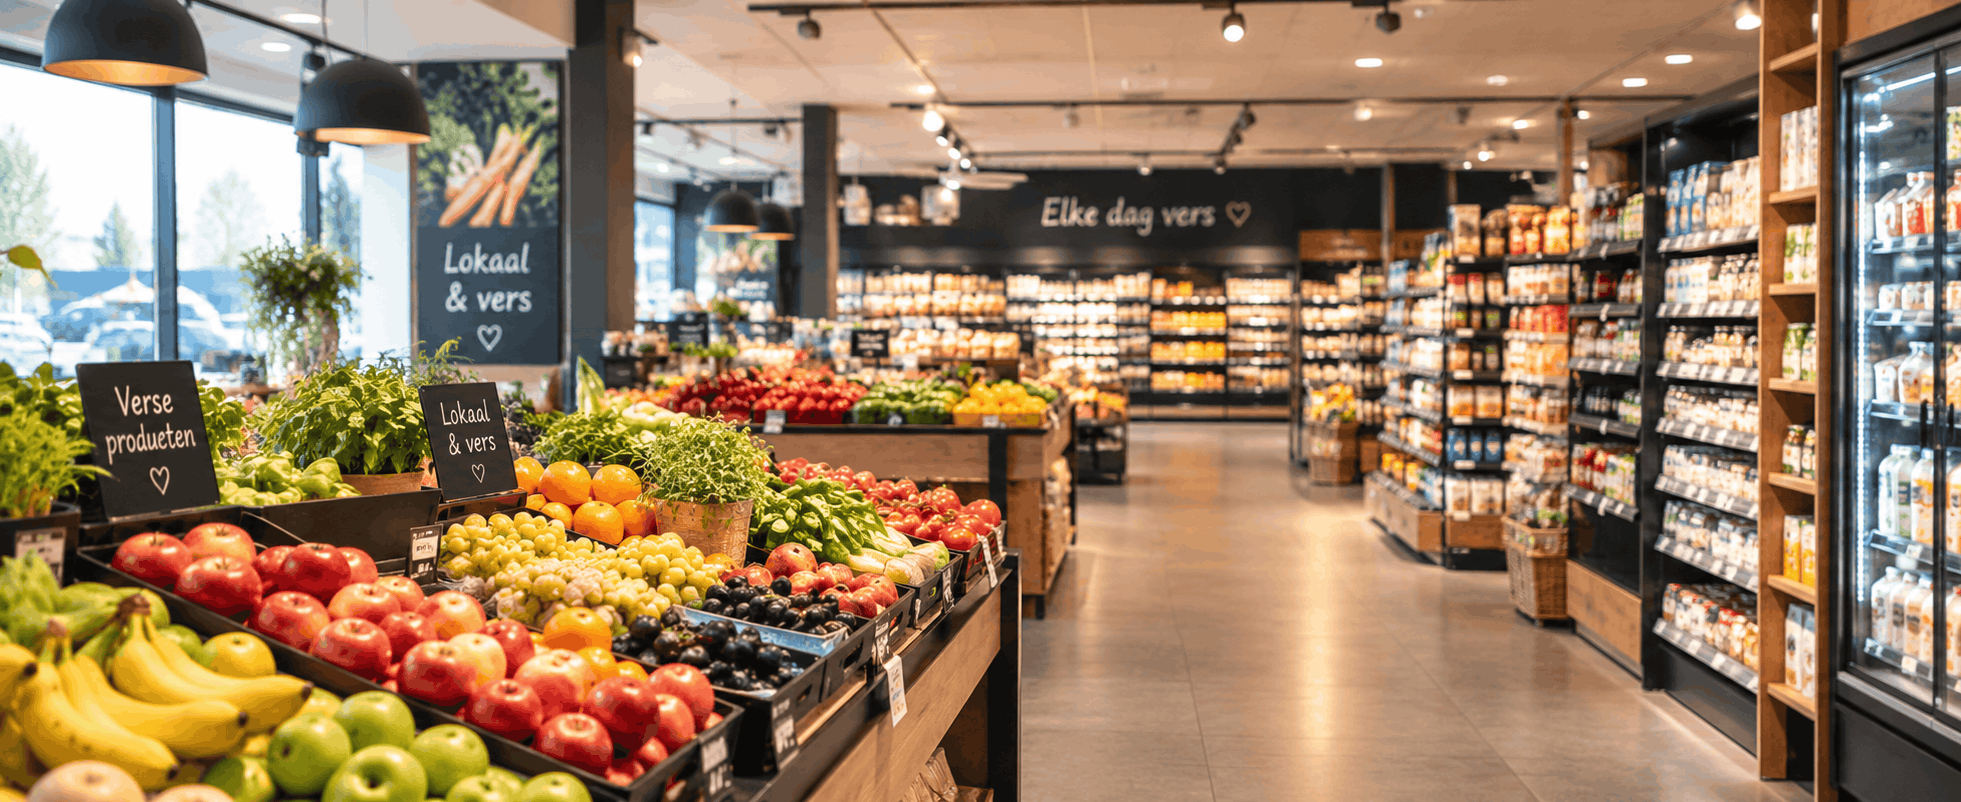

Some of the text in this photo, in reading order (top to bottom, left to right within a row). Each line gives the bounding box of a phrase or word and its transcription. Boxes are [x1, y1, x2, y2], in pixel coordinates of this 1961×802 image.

[1040, 195, 1217, 237] Elke dag vers
[444, 241, 531, 274] Lokaal
[445, 280, 533, 313] & vers
[114, 385, 174, 417] Verse
[440, 398, 491, 426] Lokaal
[448, 432, 496, 456] & vers
